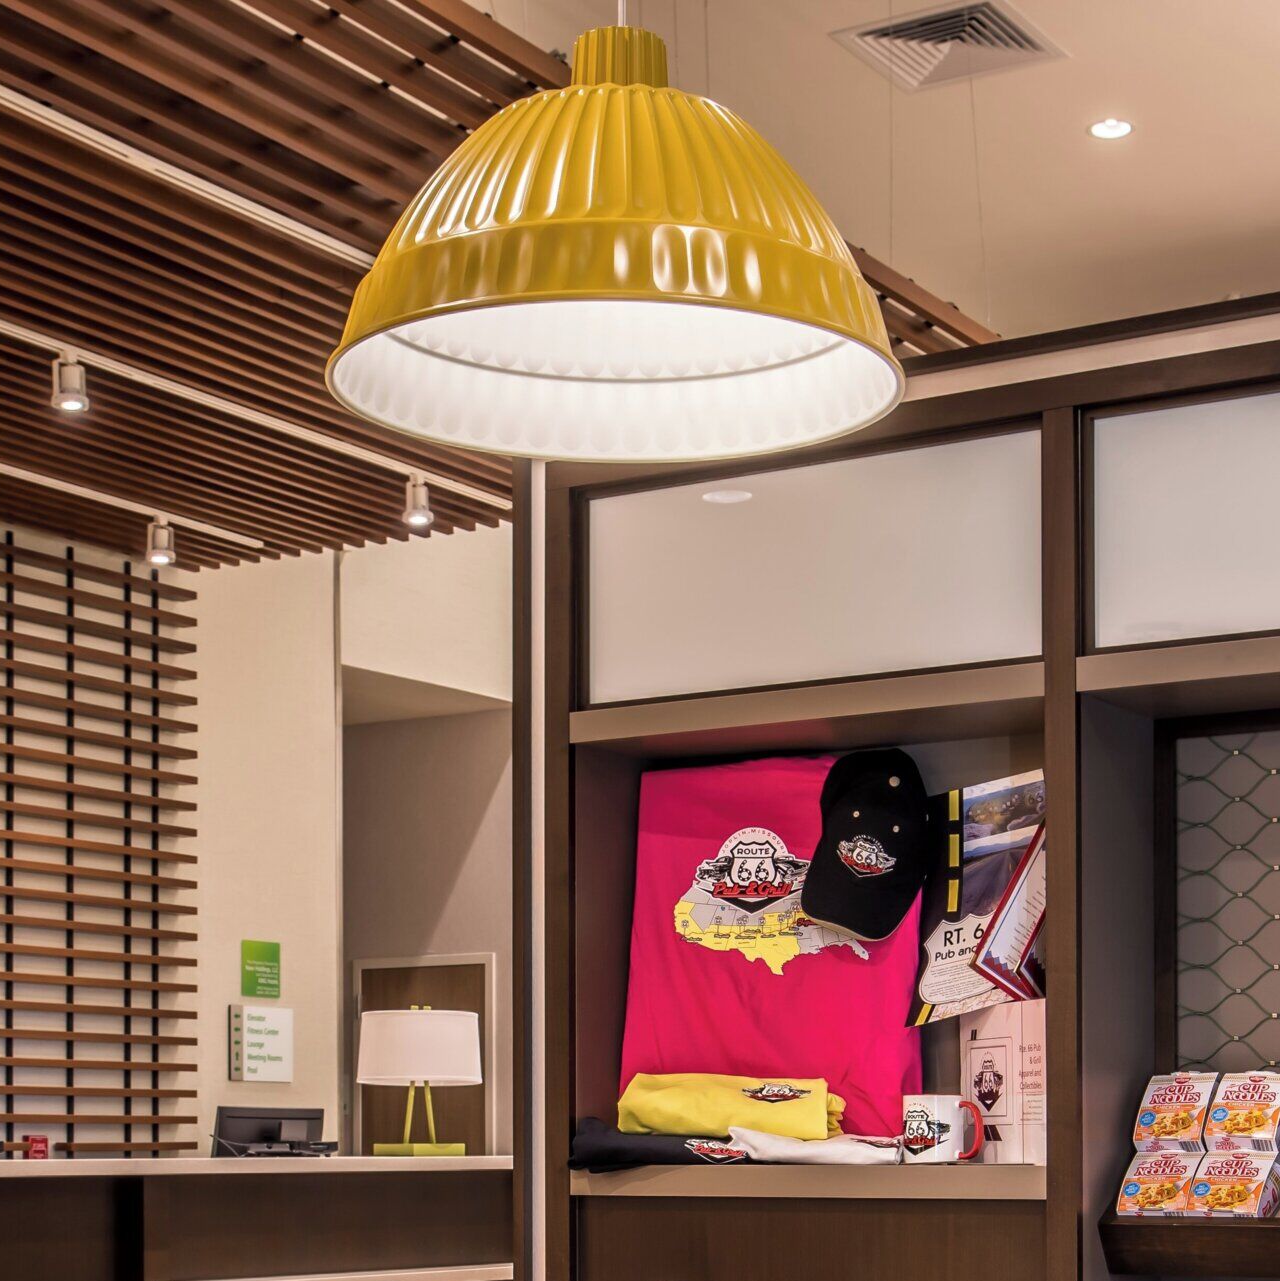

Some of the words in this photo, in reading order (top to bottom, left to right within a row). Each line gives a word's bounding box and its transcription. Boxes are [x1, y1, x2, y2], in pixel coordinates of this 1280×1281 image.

[737, 847, 770, 855] ROUTE
[855, 851, 873, 864] 66
[737, 859, 770, 882] 66
[713, 882, 742, 895] Pub
[746, 881, 759, 895] &
[759, 881, 793, 896] Grill
[943, 928, 966, 947] RT.
[973, 923, 984, 940] 6
[935, 949, 955, 962] Pub
[984, 1073, 993, 1089] 66
[1165, 1084, 1194, 1095] CUP
[1238, 1083, 1270, 1093] CUP
[1149, 1092, 1201, 1104] NOODLES
[1222, 1091, 1277, 1102] NOODLES
[908, 1121, 925, 1136] 66
[1150, 1159, 1181, 1169] CUP
[1221, 1159, 1253, 1169] CUP
[1134, 1166, 1188, 1177] NOODLES
[1204, 1166, 1259, 1177] NOODLES
